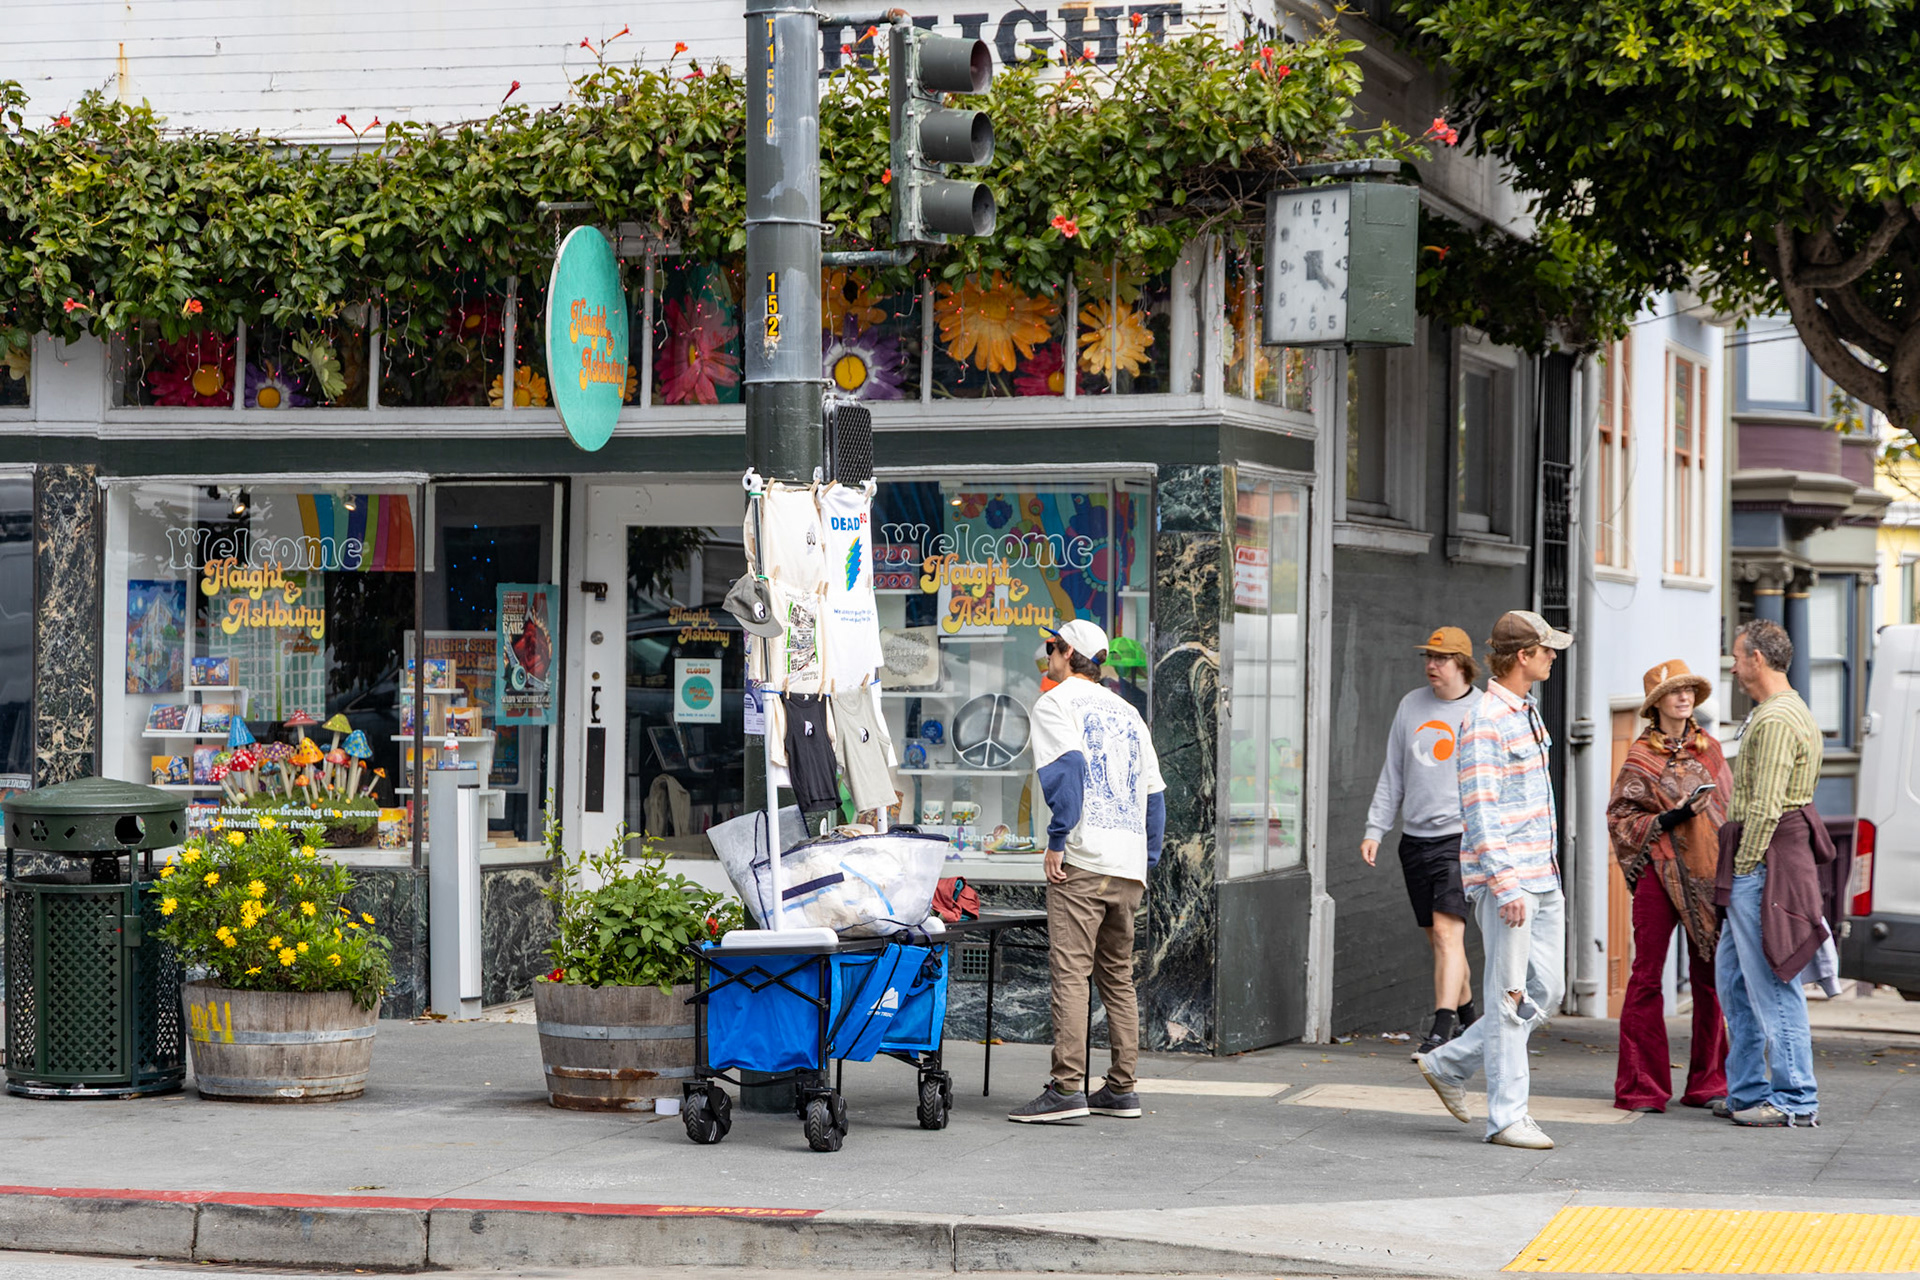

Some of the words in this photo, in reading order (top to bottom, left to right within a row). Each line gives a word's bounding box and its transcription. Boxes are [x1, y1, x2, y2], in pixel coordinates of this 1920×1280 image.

[818, 3, 1182, 78] HIGHT
[766, 18, 776, 139] T1500
[1312, 199, 1322, 215] 12
[1332, 198, 1337, 214] 1
[1280, 259, 1288, 274] 9
[1342, 255, 1349, 271] 3
[767, 273, 779, 336] 152
[570, 297, 607, 351] Haight
[1290, 318, 1297, 332] 7
[1308, 316, 1316, 331] 6
[1328, 315, 1336, 329] 5
[579, 346, 624, 399] Ashbury
[830, 517, 860, 531] DEAD
[859, 512, 868, 524] 60
[165, 527, 363, 570] Welcome
[806, 532, 816, 545] 60
[880, 523, 1094, 568] Welcome
[200, 557, 287, 600] Haight
[283, 581, 302, 604] &
[920, 553, 1012, 598] Haight
[1008, 578, 1029, 602] &
[221, 597, 325, 640] Ashbury
[502, 622, 524, 635] FAIR
[668, 607, 711, 628] Haight
[942, 595, 1054, 638] Ashbury
[678, 625, 730, 648] Ashbury
[189, 818, 209, 827] and
[200, 807, 219, 815] our
[221, 805, 264, 819] history,
[342, 807, 382, 819] present
[960, 832, 994, 842] Learn
[1004, 833, 1038, 843] Share
